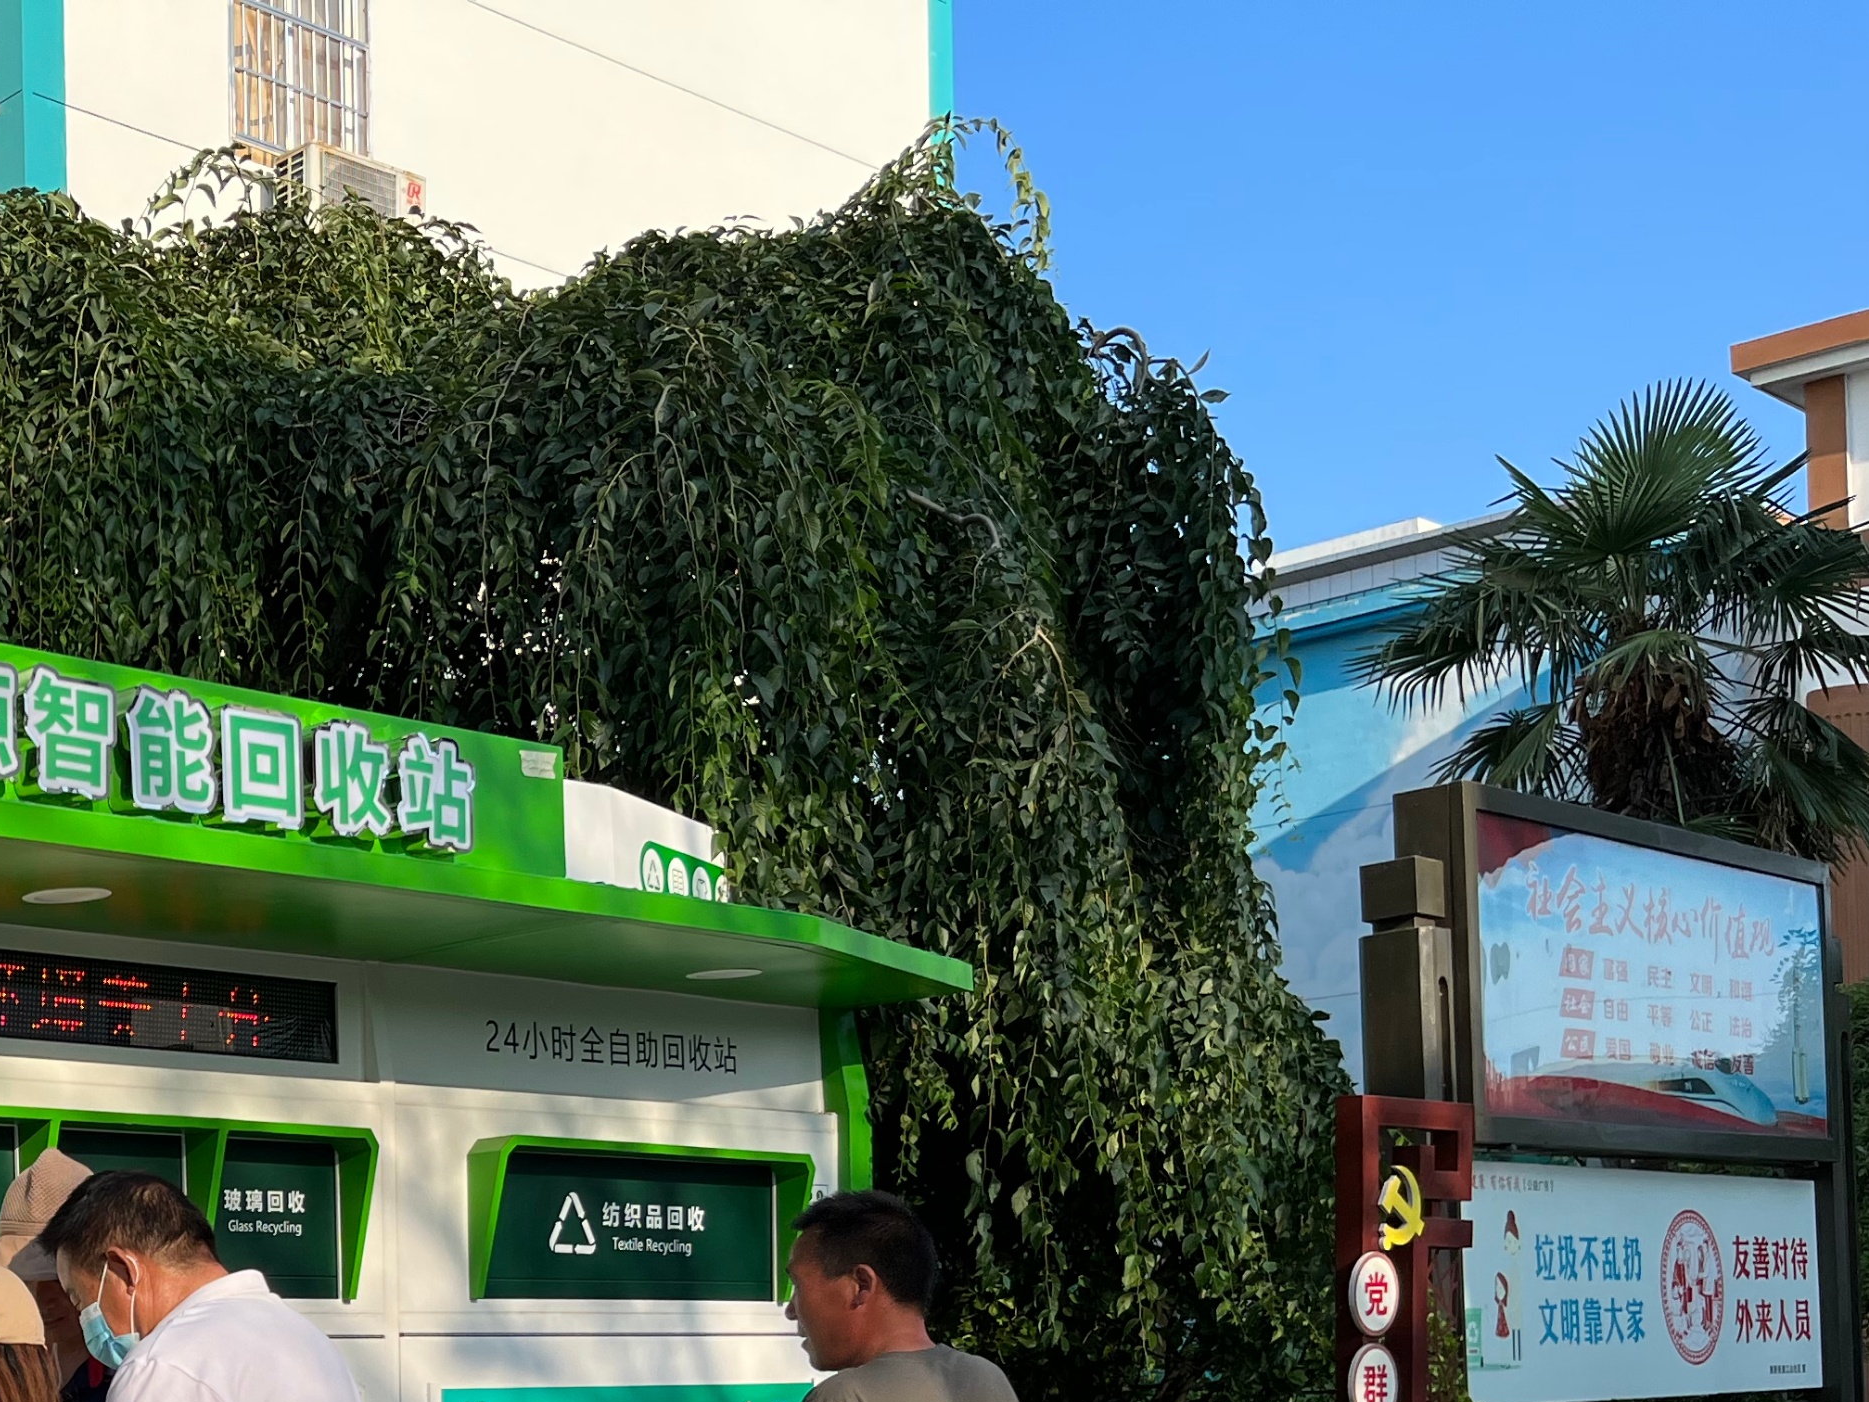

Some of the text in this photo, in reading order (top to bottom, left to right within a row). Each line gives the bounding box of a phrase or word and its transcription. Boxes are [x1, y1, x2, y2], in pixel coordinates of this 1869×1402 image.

[1526, 860, 1775, 966] 社会主义核心价值观
[1647, 964, 1673, 989] 民主
[1689, 971, 1713, 996] 文明
[1564, 994, 1753, 1039] 社会 自由 平等 公正 法治
[485, 1018, 738, 1076] 24小时全自助回收站
[223, 1187, 306, 1214] 玻璃回收
[601, 1201, 706, 1232] 纺织品回收
[227, 1218, 303, 1236] Glass Recycling
[611, 1236, 693, 1257] Textile Recycling
[1534, 1233, 1643, 1282] 垃圾不乱扔
[1732, 1234, 1809, 1281] 友善对待
[1538, 1298, 1646, 1346] 文明靠大家
[1735, 1298, 1813, 1344] 外来人员
